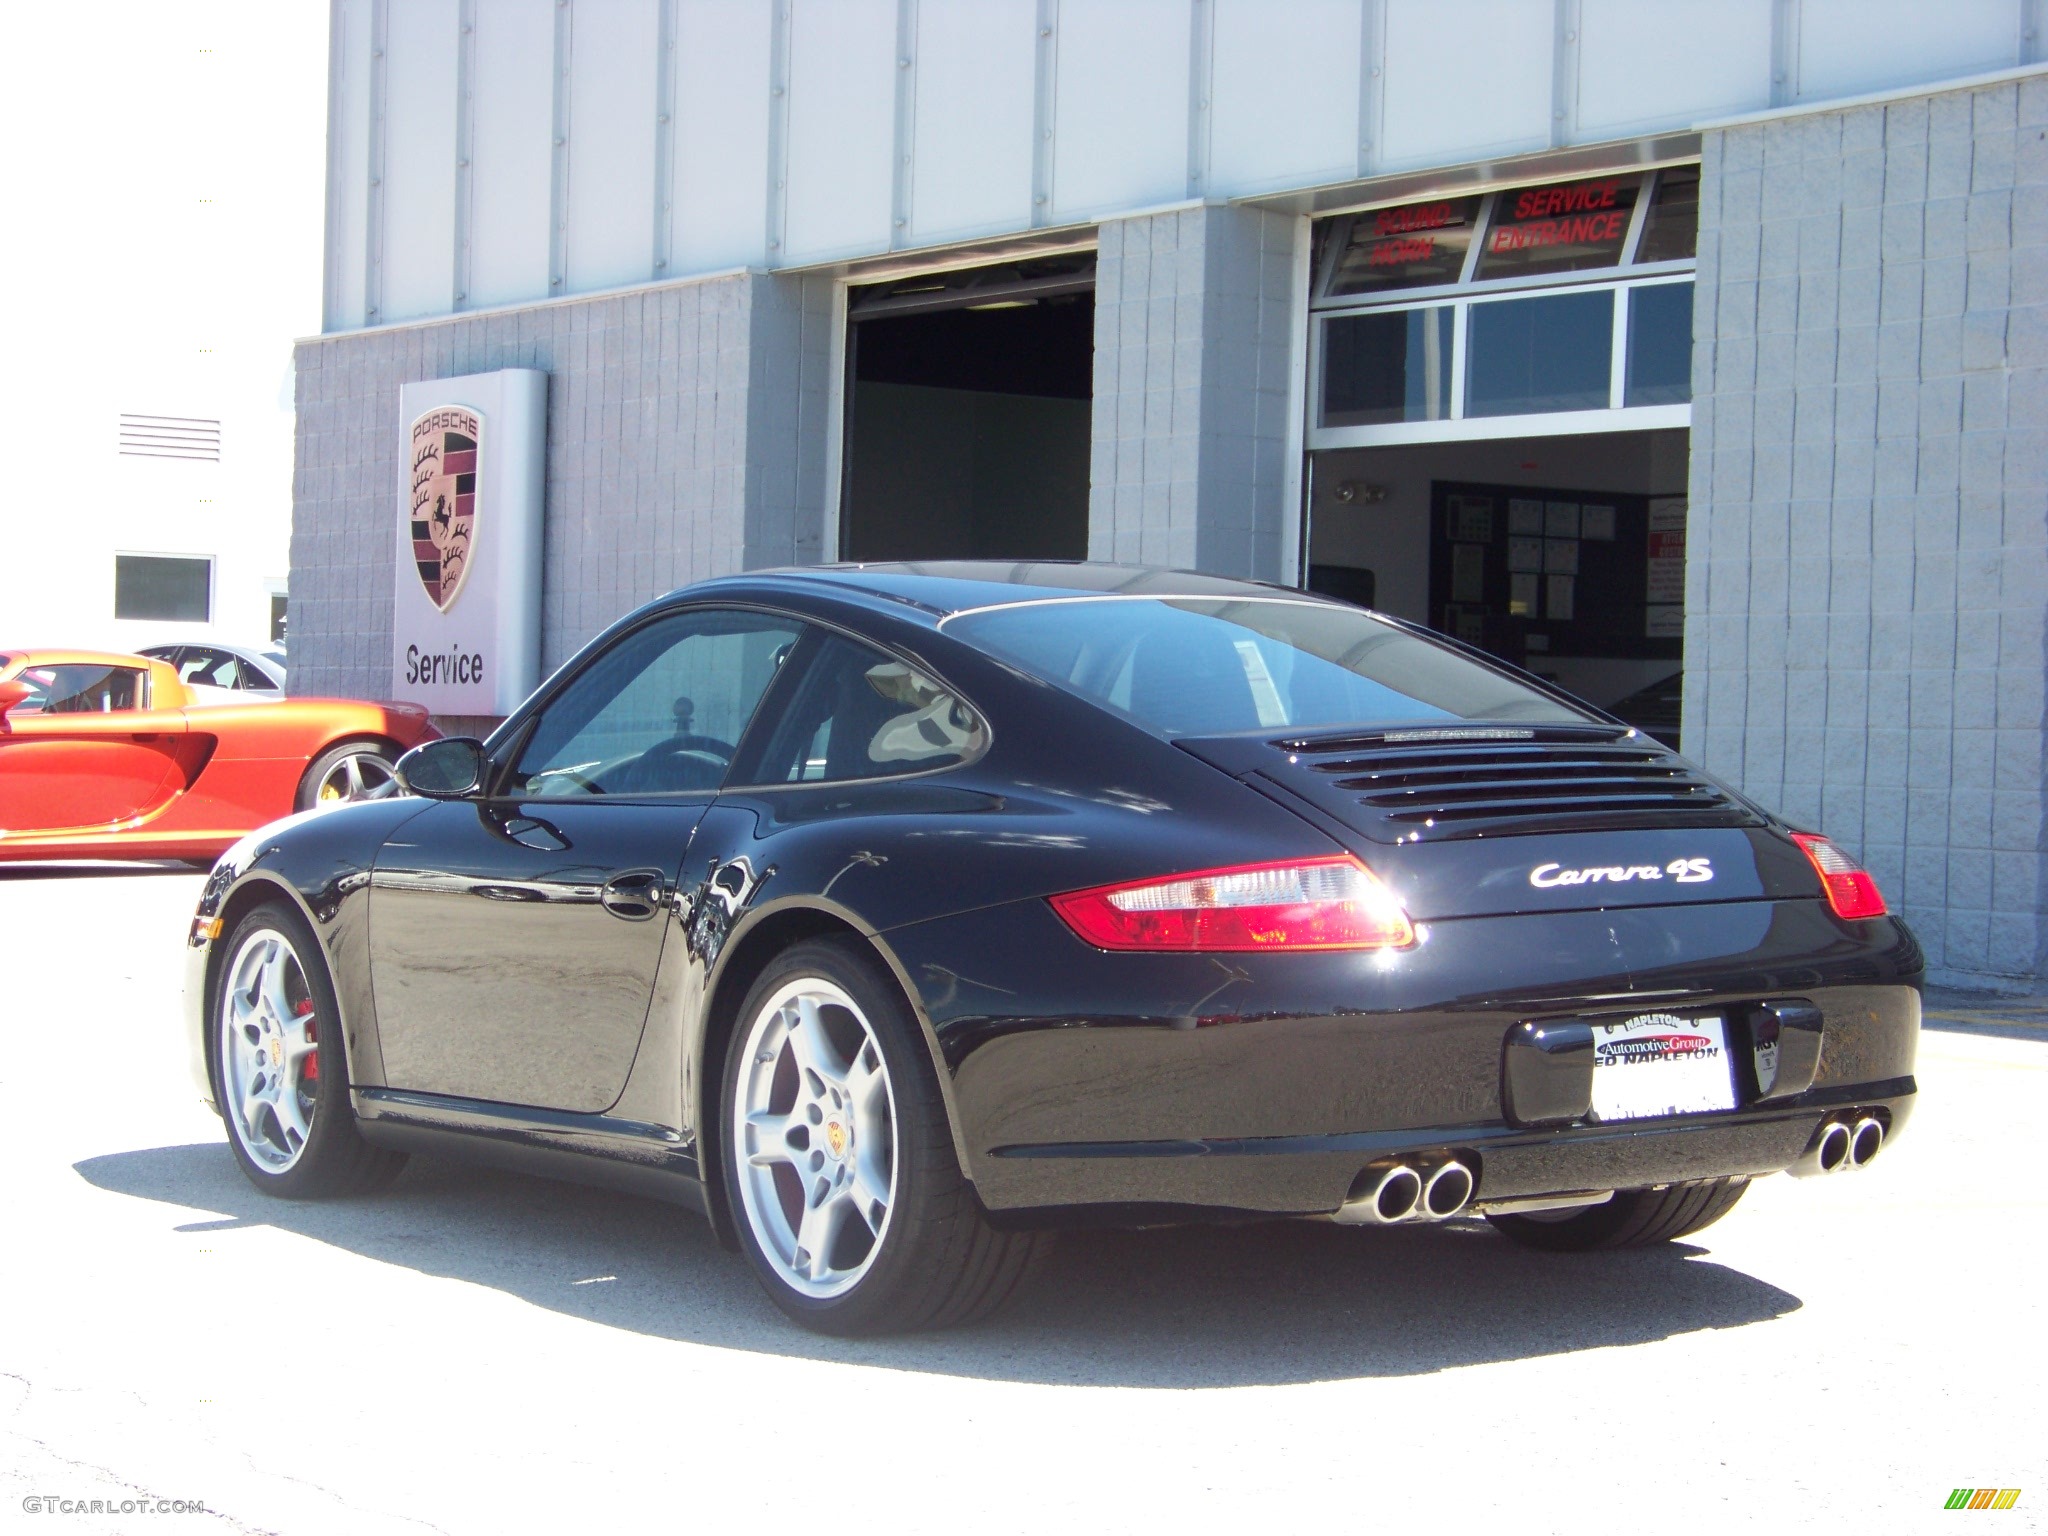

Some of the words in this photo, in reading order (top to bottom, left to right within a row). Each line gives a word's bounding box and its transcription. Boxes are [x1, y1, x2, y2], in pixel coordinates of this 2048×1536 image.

[1514, 180, 1620, 219] SERVICE
[1374, 204, 1450, 236] SOUND
[1493, 212, 1625, 254] ENTRANCE
[1370, 236, 1434, 266] HORN
[413, 412, 477, 443] PORSCHE
[406, 643, 483, 684] Service
[1530, 862, 1663, 888] Carrera
[1666, 858, 1714, 882] 4S
[1625, 1013, 1681, 1032] NAPLETON
[1594, 1055, 1617, 1067] ED
[1624, 1047, 1719, 1065] NAPLETON
